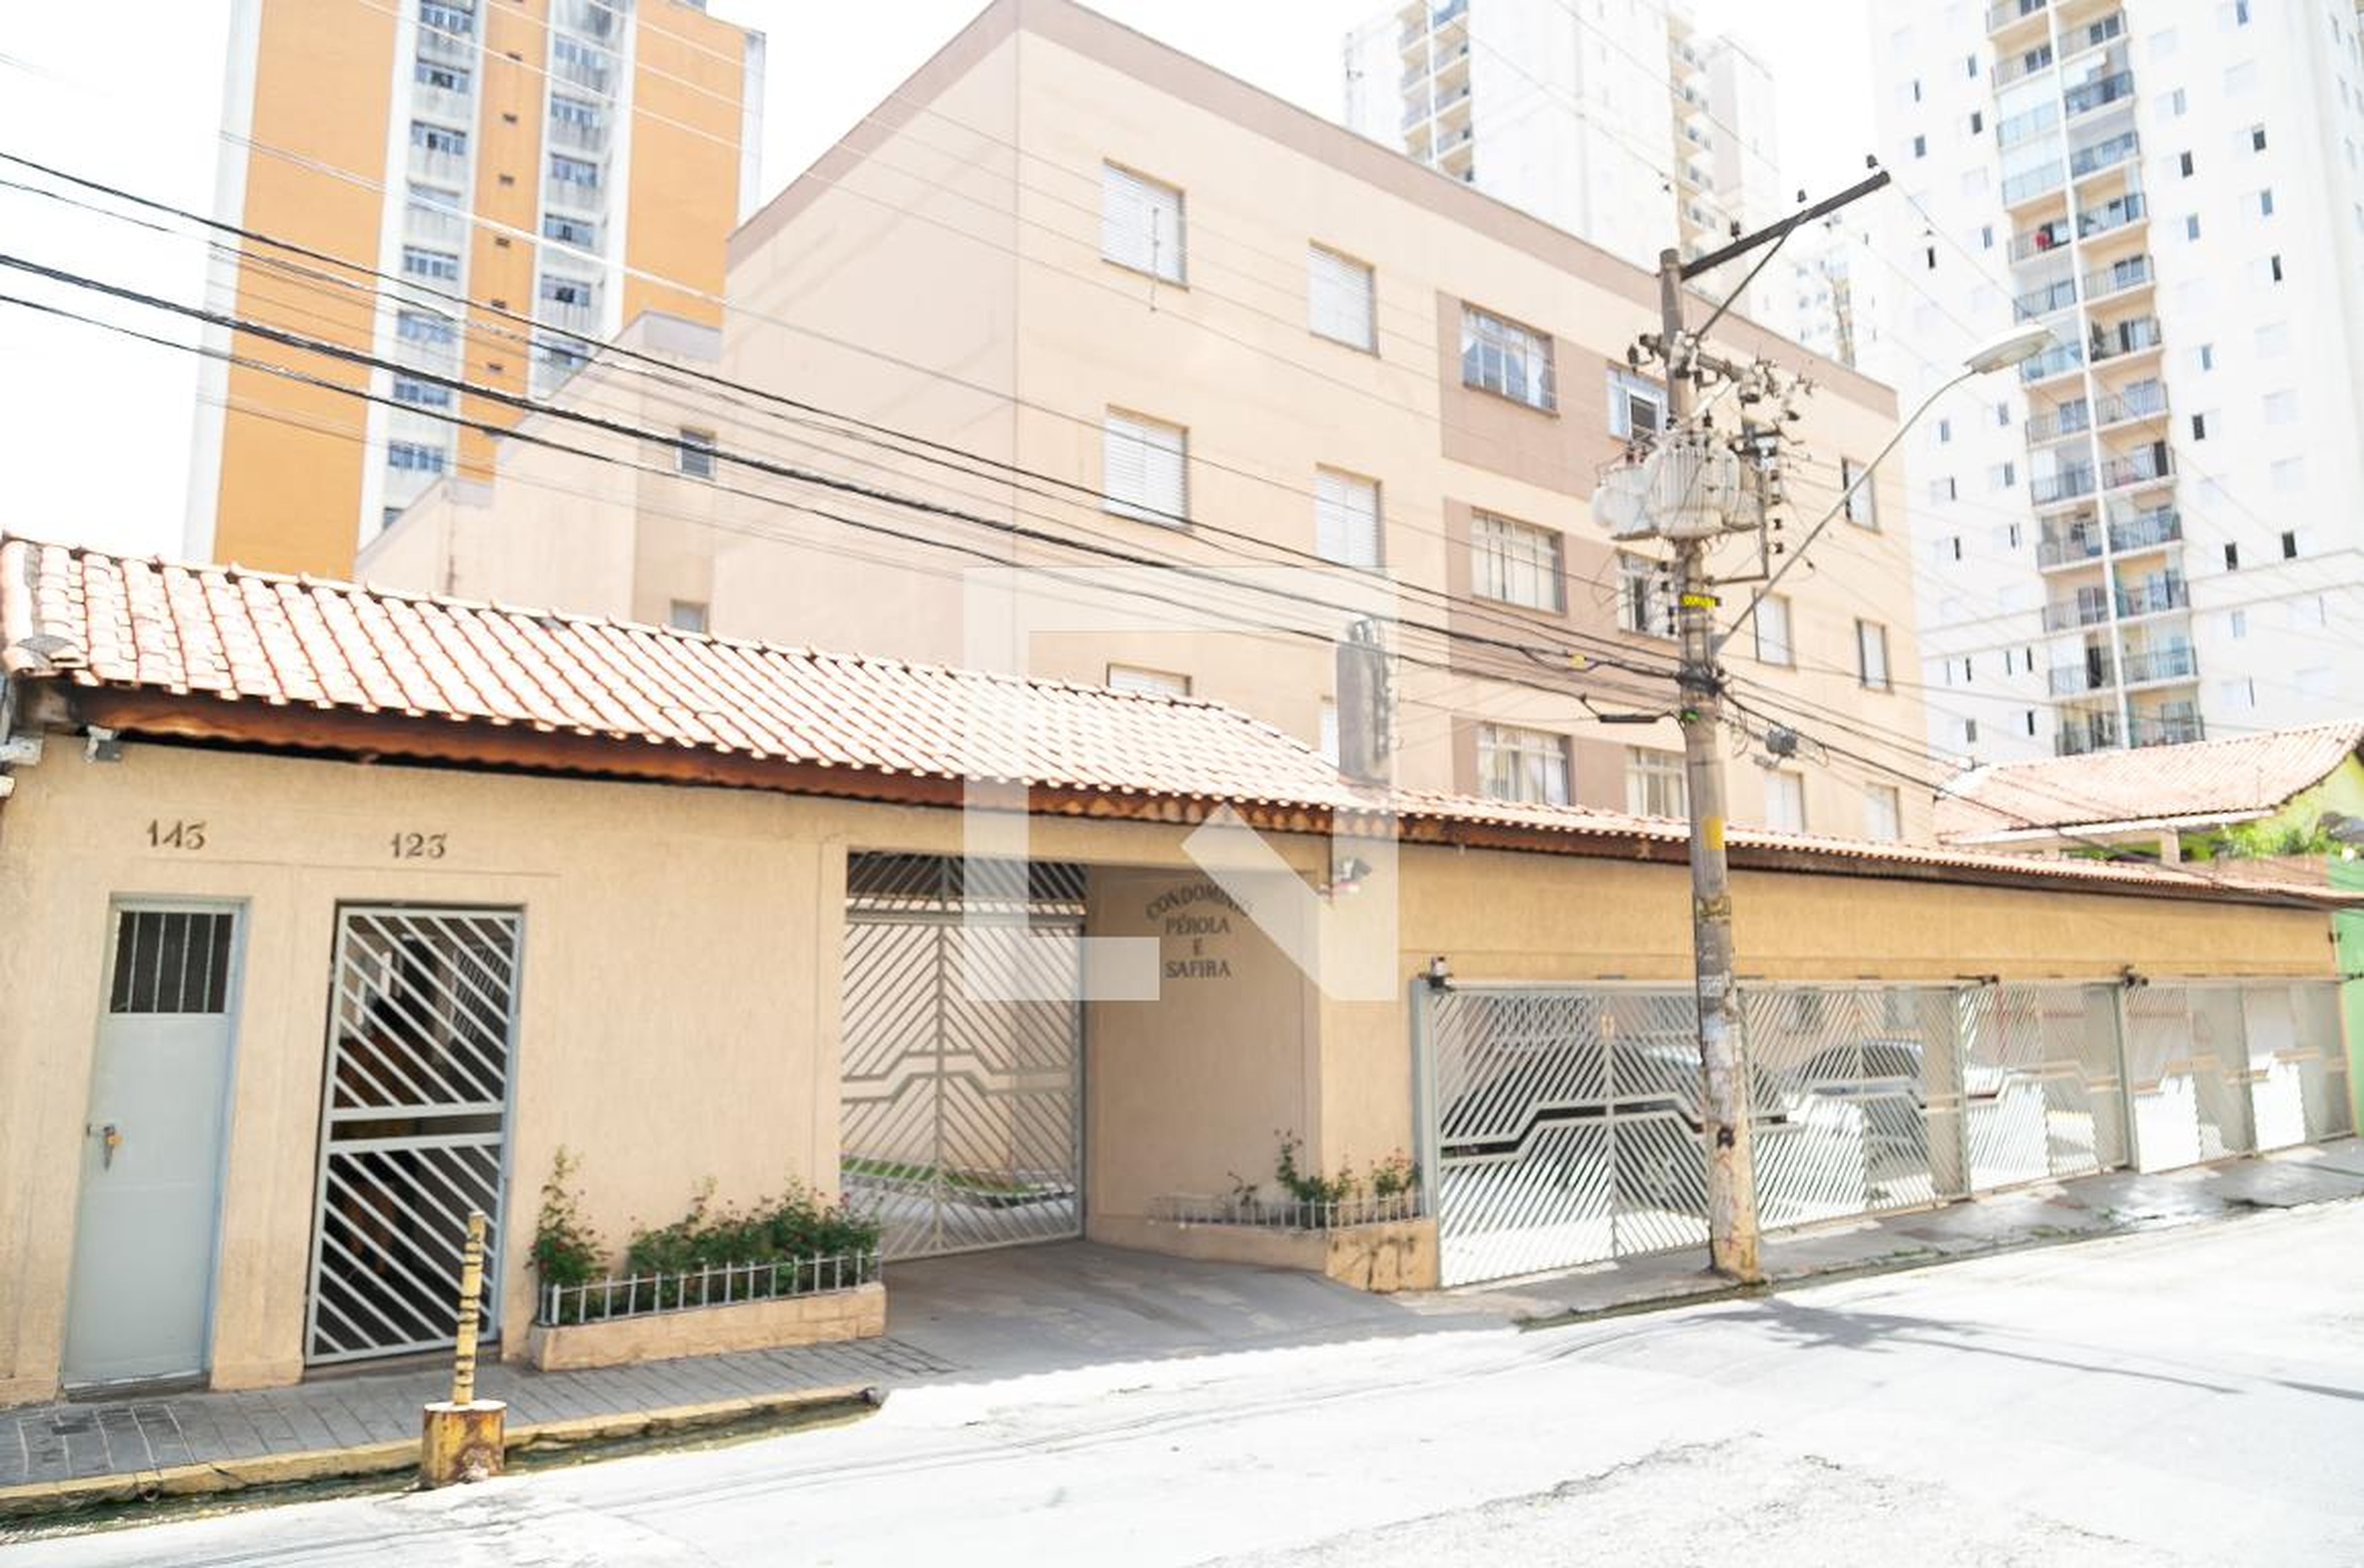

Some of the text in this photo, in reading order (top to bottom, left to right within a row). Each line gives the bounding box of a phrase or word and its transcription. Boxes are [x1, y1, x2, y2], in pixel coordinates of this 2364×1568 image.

[391, 832, 448, 859] 123
[1146, 883, 1256, 921] CONDOM
[1165, 914, 1231, 935] PÉROLA
[1193, 938, 1203, 956] E
[1165, 960, 1231, 979] SAFIRA
